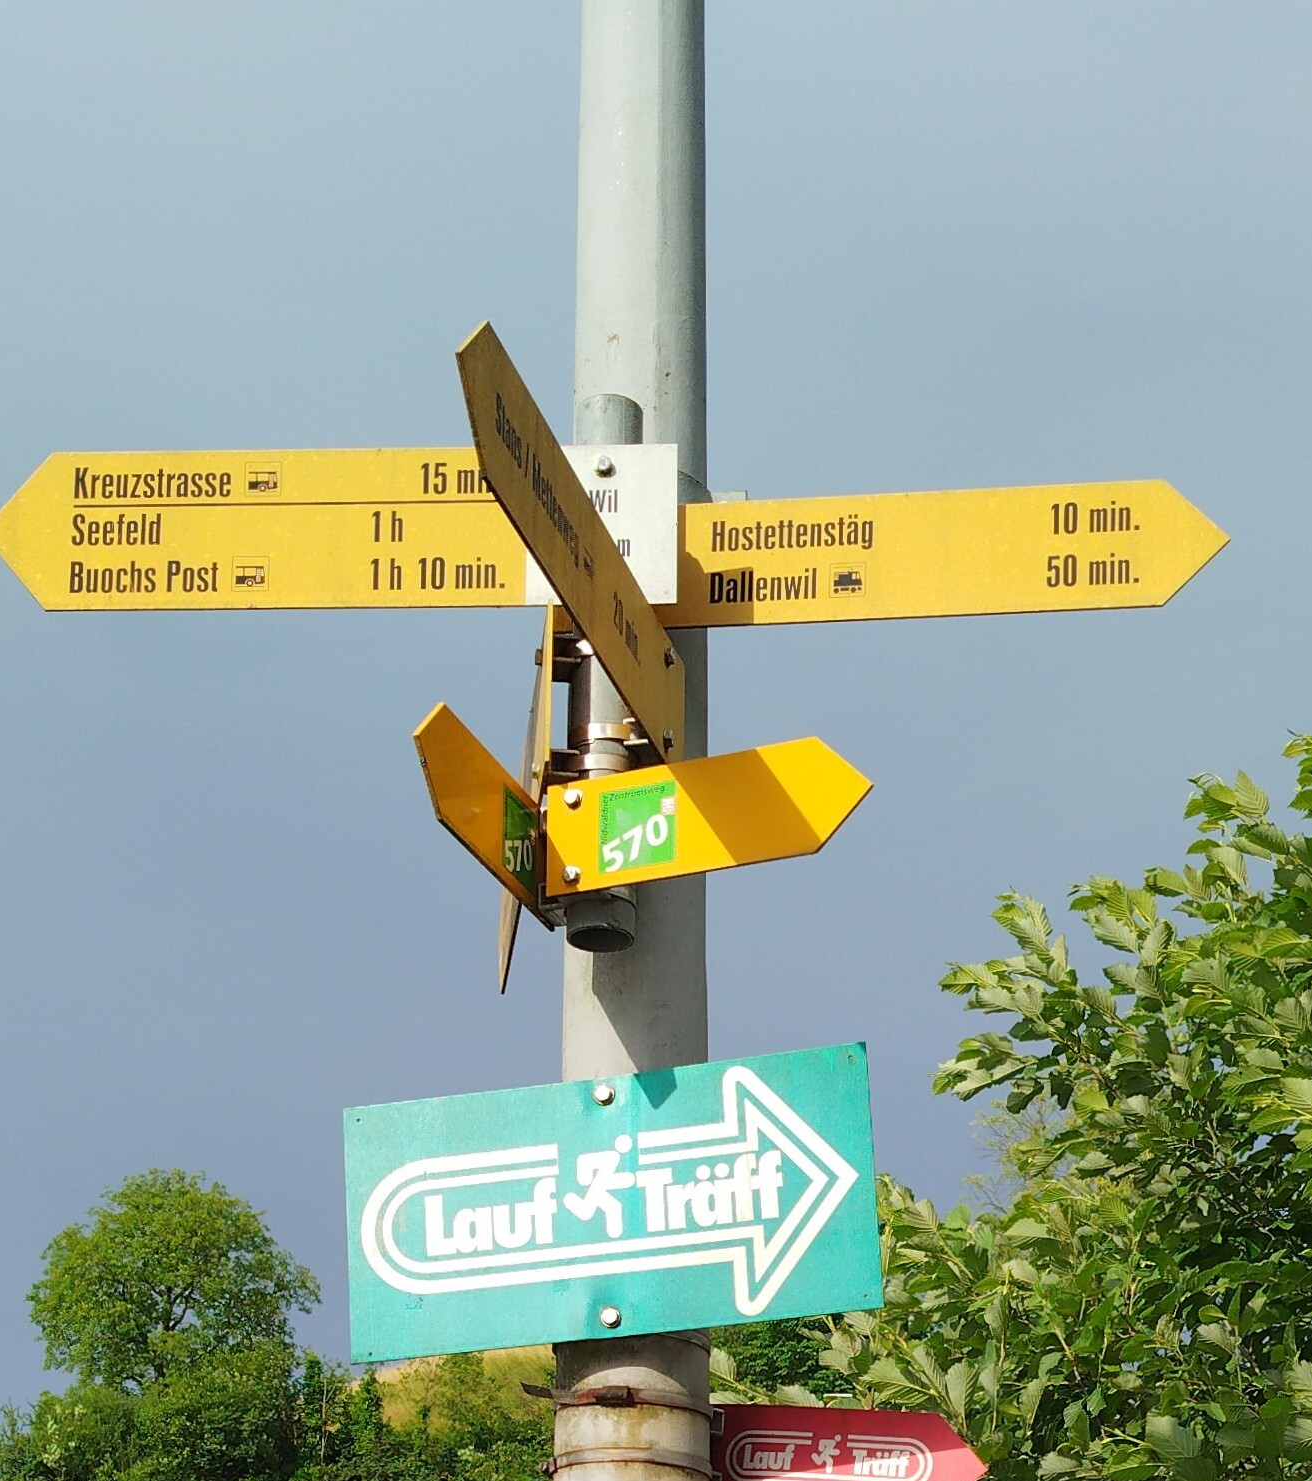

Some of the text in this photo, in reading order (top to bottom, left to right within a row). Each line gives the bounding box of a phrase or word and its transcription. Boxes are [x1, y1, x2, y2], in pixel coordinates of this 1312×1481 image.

[495, 391, 523, 471] Stans
[74, 467, 232, 500] Kreuzstrasse
[420, 462, 448, 495] 15
[71, 510, 404, 546] Seefeld 1 h
[711, 500, 1140, 552] Hostettenstäg 10 min.
[69, 557, 506, 594] Buochs Post 1 h 10 min.
[709, 552, 1140, 604] Dallenwil 50 min.
[613, 591, 625, 637] 20
[504, 839, 533, 873] 570
[602, 813, 669, 873] 570
[424, 1150, 784, 1257] Lauf Träff
[743, 1443, 911, 1478] Lauf Träff
